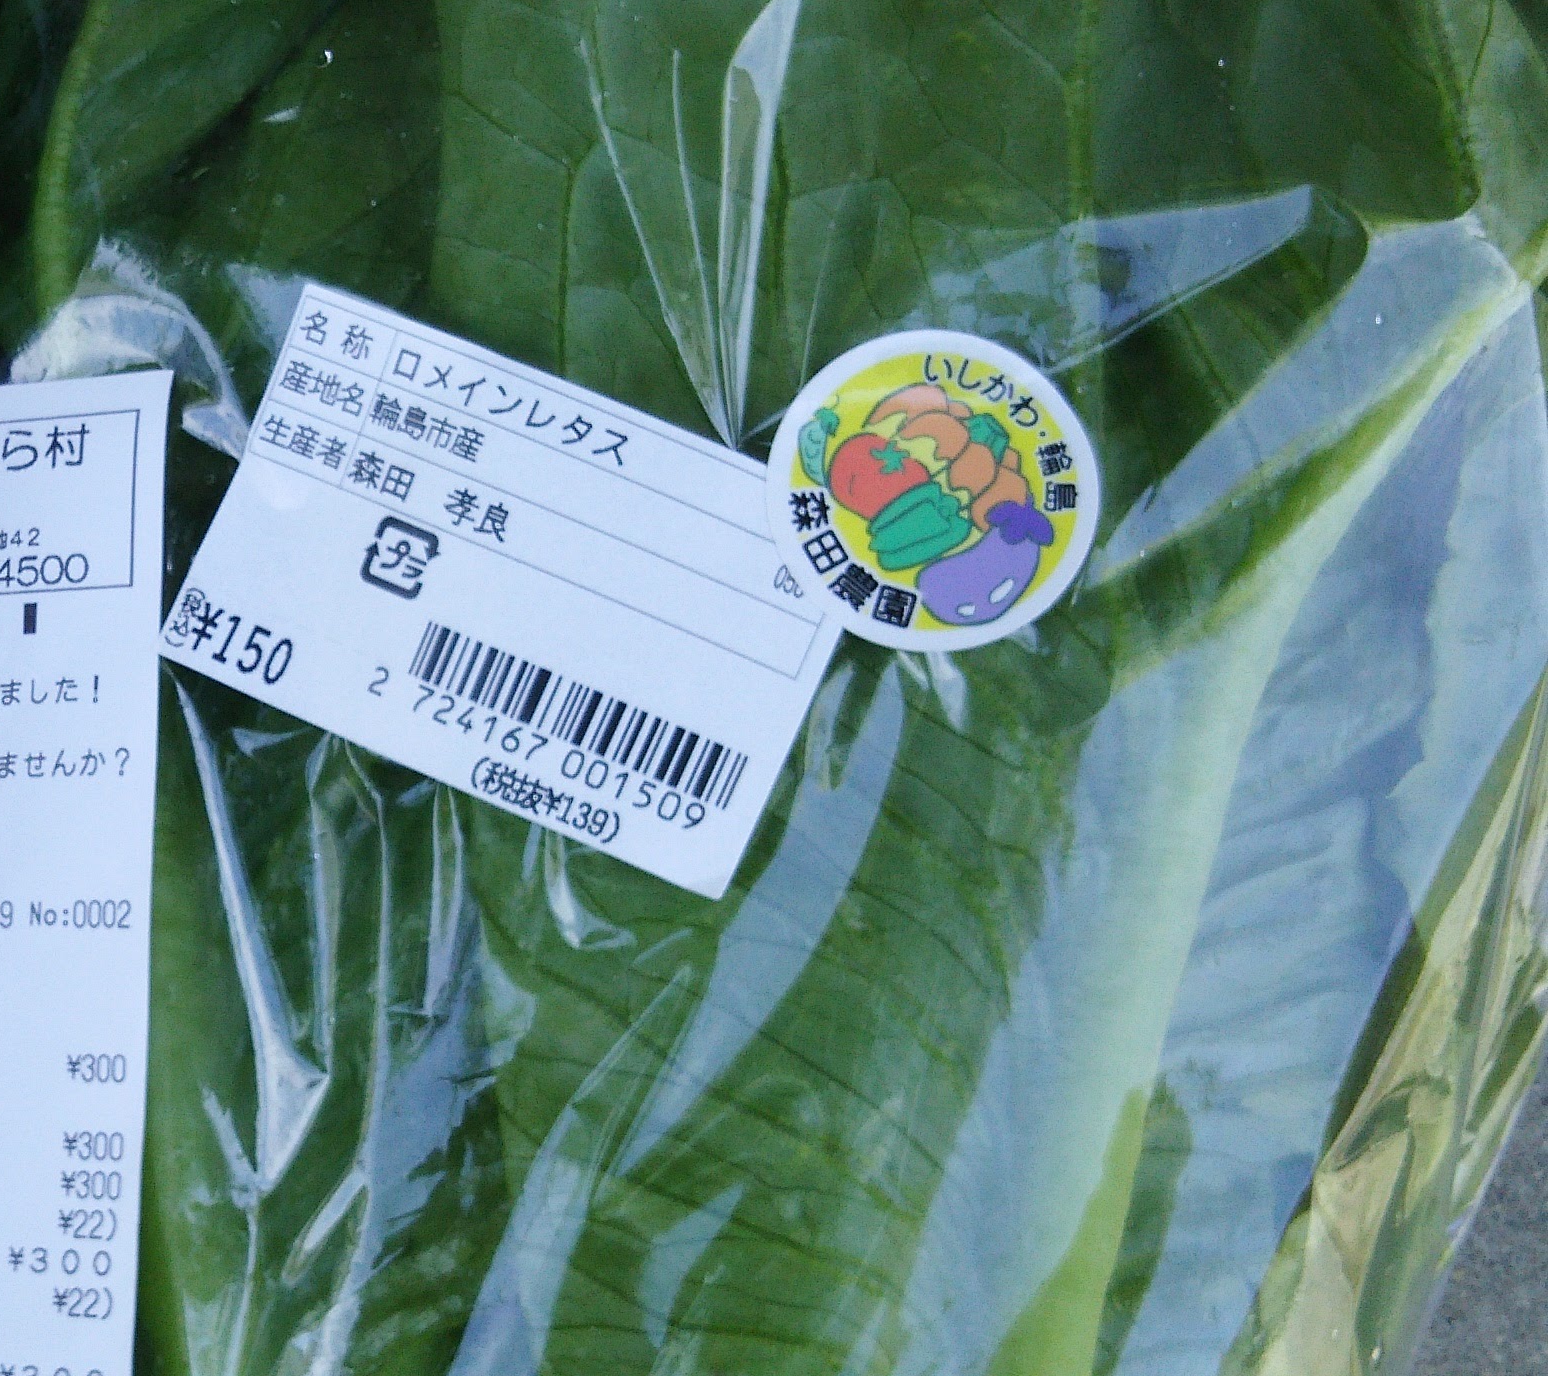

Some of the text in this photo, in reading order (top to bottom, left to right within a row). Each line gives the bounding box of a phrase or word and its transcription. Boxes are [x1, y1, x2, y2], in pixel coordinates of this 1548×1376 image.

[279, 359, 485, 463] 産地名 輪島市産
[300, 310, 628, 466] 名称 ロメインレタス
[259, 414, 510, 543] 生産者 森田 孝良
[788, 490, 918, 628] 森田農園
[192, 602, 293, 685] ¥150
[367, 666, 706, 830] 2 724167 001509
[29, 899, 132, 928] No:0002
[67, 1054, 126, 1083] ¥300
[63, 1131, 124, 1161] ¥300
[61, 1170, 122, 1200] ¥300
[58, 1208, 117, 1241] ¥22)
[52, 1285, 114, 1320] ¥22)
